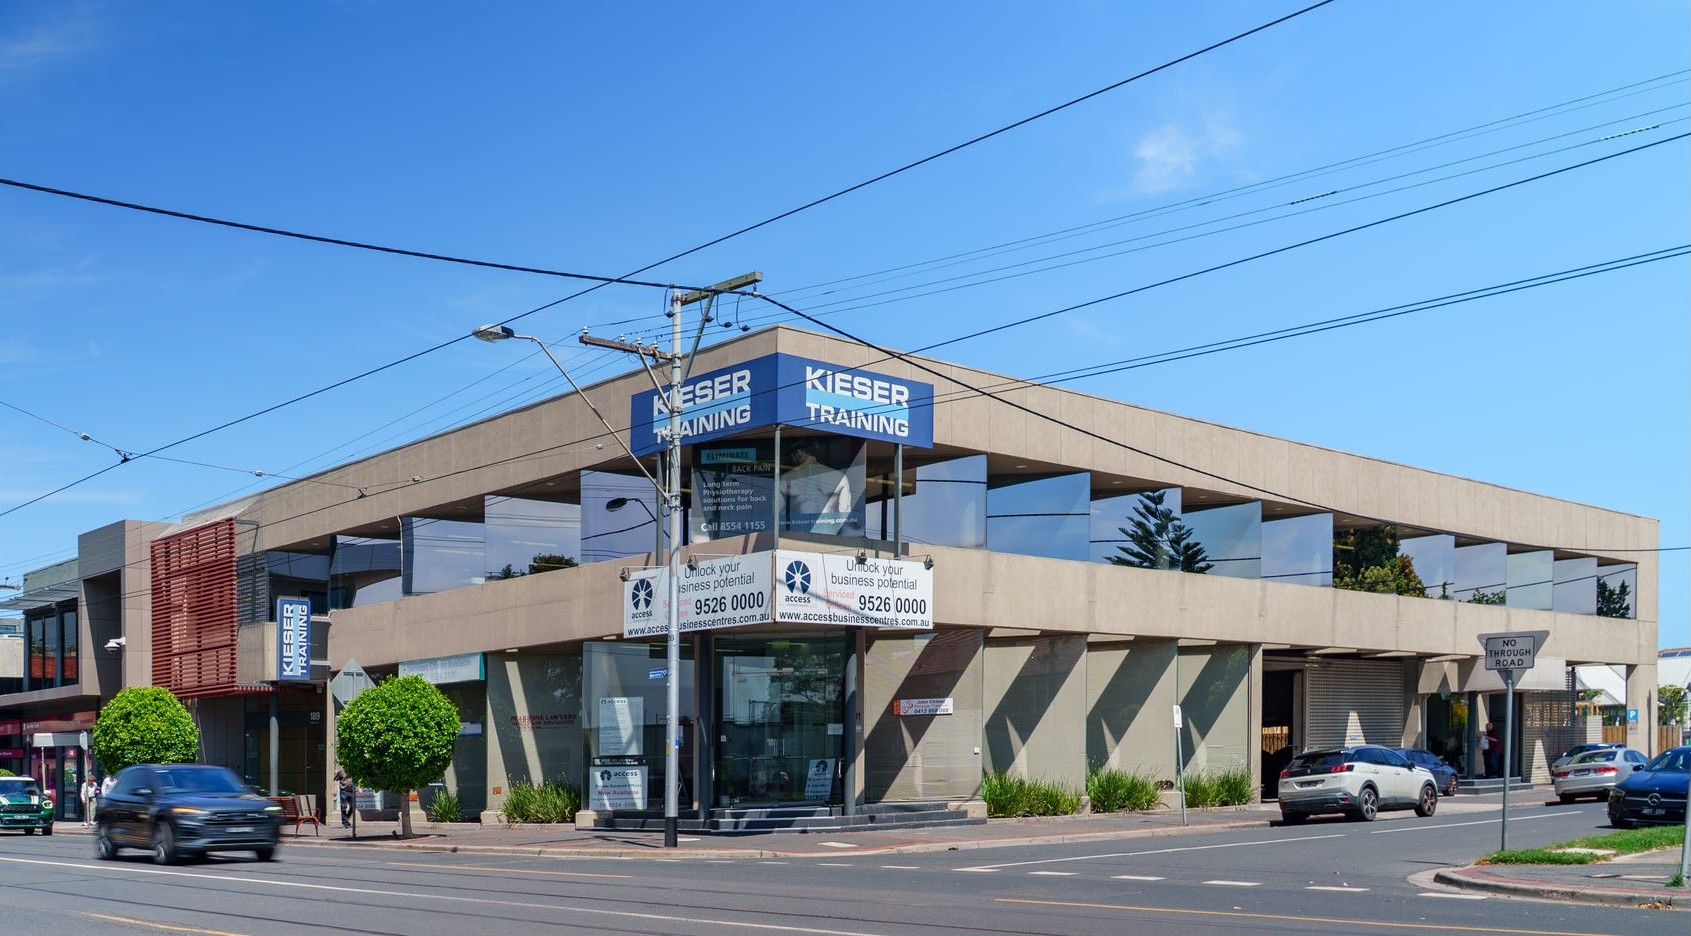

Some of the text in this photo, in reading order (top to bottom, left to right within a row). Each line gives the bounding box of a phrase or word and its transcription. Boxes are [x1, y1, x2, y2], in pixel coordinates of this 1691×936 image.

[653, 369, 751, 416] KESER
[806, 366, 909, 408] KIESER
[653, 404, 751, 444] TAINING
[806, 401, 909, 437] TRAINING
[706, 451, 749, 460] ELIMINATE
[732, 464, 771, 473] BACK PAIN
[703, 488, 754, 497] Physiotherapy
[736, 503, 752, 511] pain
[700, 520, 766, 532] Call 8554 1155
[685, 562, 741, 579] Unlock your
[846, 559, 904, 577] Unlock your
[713, 572, 755, 592] potential
[831, 572, 917, 590] business potential
[784, 594, 811, 604] access
[823, 589, 855, 599] Serviced
[694, 596, 727, 616] 9526
[731, 591, 764, 611] 0000
[858, 595, 926, 615] 9526 0000
[631, 610, 653, 619] access
[779, 611, 930, 627] www.accessbusinesscentres.com.au
[282, 603, 294, 676] KIESER
[298, 604, 308, 676] TRAINING
[1502, 639, 1517, 648] NO
[1489, 648, 1531, 658] THROUGH
[1495, 658, 1524, 667] ROAD
[310, 712, 320, 720] 189
[1630, 710, 1636, 719] P
